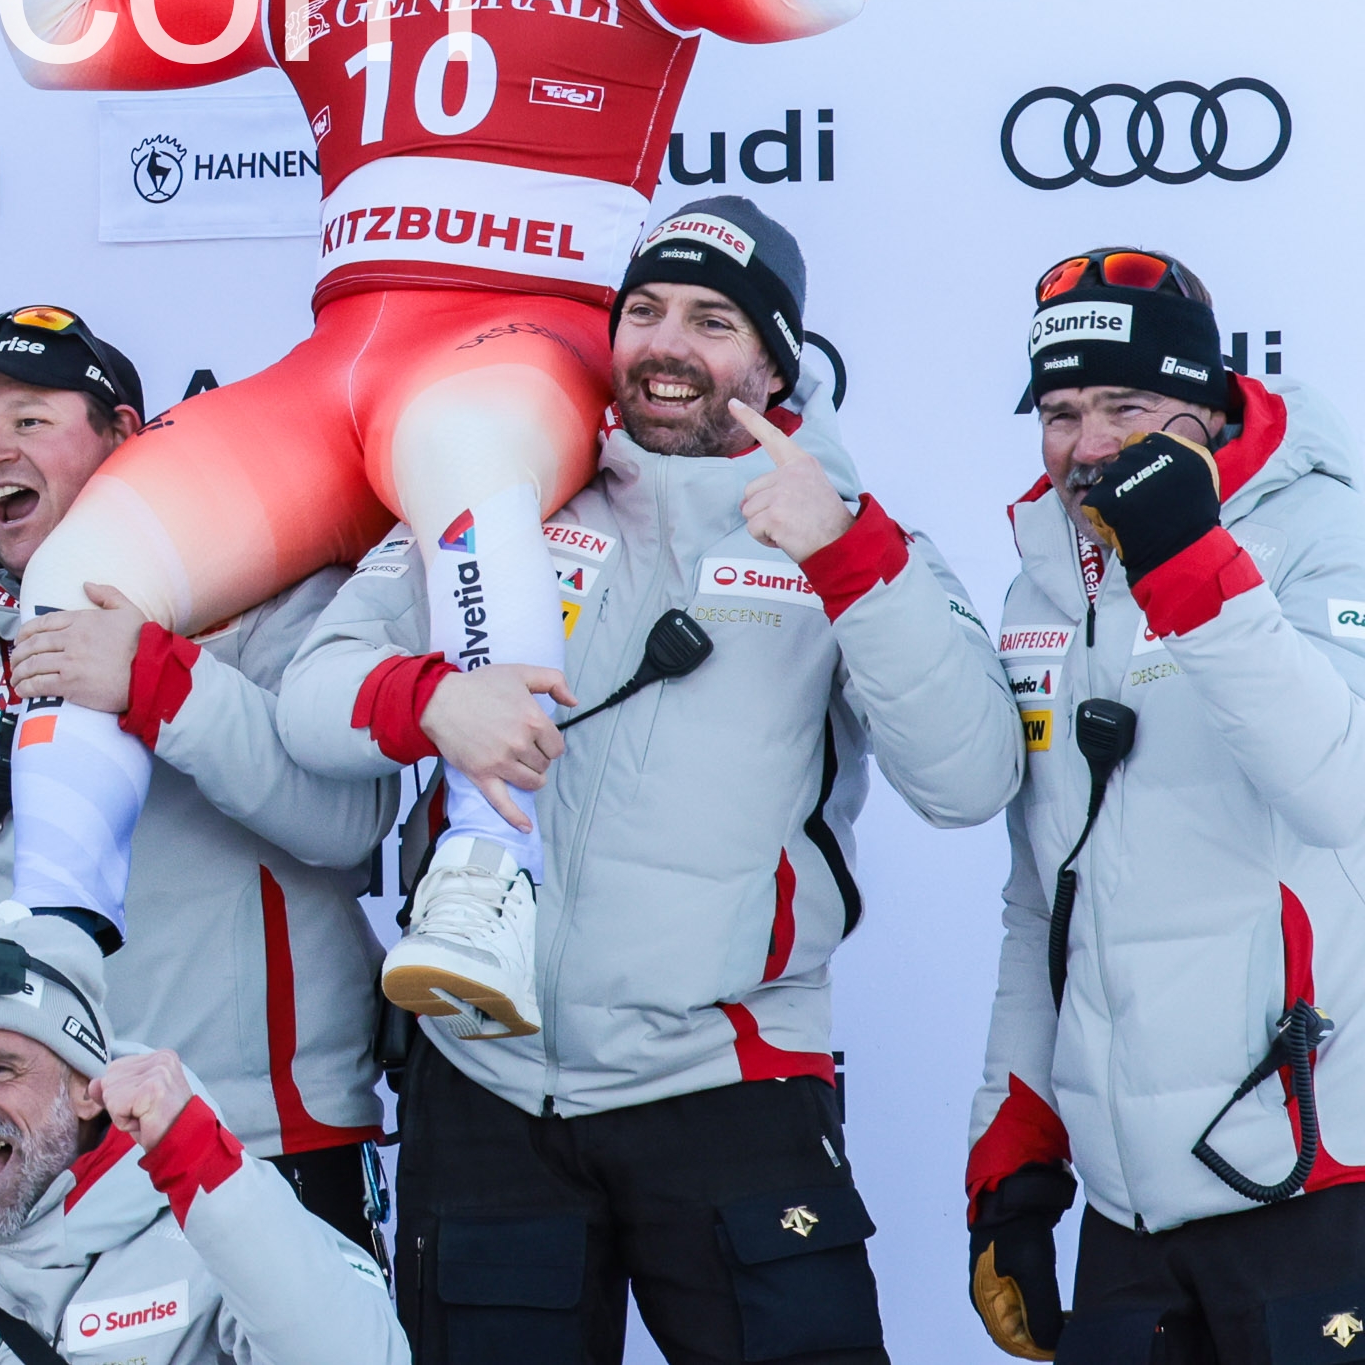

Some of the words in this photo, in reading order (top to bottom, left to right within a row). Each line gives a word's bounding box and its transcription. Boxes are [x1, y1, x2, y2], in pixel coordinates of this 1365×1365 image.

[344, 32, 498, 146] 10
[542, 85, 595, 103] Tirol
[659, 109, 835, 184] udi
[666, 219, 746, 254] Sunrise
[1044, 310, 1123, 336] Sunrise
[1175, 364, 1209, 382] reusch
[1115, 453, 1174, 498] reusch
[695, 606, 782, 628] DESCENTE
[999, 632, 1069, 652] RAIFFEISEN
[105, 1300, 178, 1330] Sunrise
